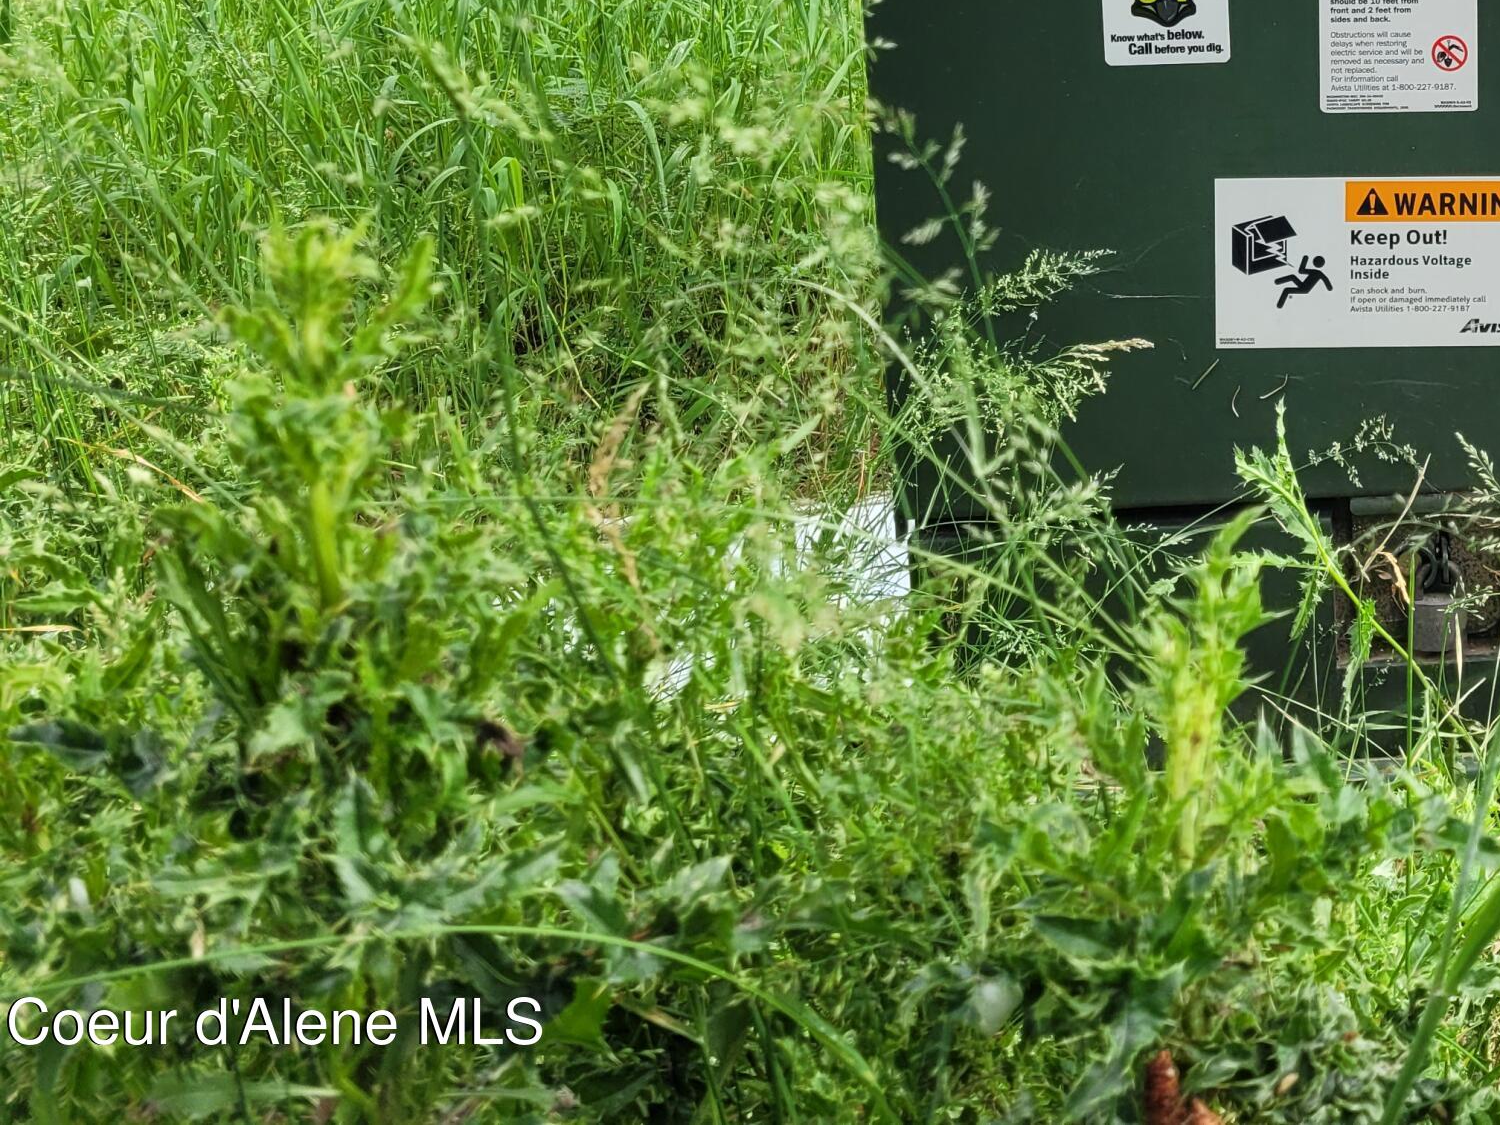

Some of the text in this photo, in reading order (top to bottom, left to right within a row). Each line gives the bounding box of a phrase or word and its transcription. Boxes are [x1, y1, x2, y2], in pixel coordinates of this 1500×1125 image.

[1111, 29, 1204, 42] Know what's below.
[1129, 43, 1224, 55] Call before you dig.
[1350, 229, 1447, 249] Keep Out!
[1350, 255, 1472, 268] Hazardous Voltage
[1350, 269, 1389, 279] Inside
[1425, 296, 1470, 304] immediately
